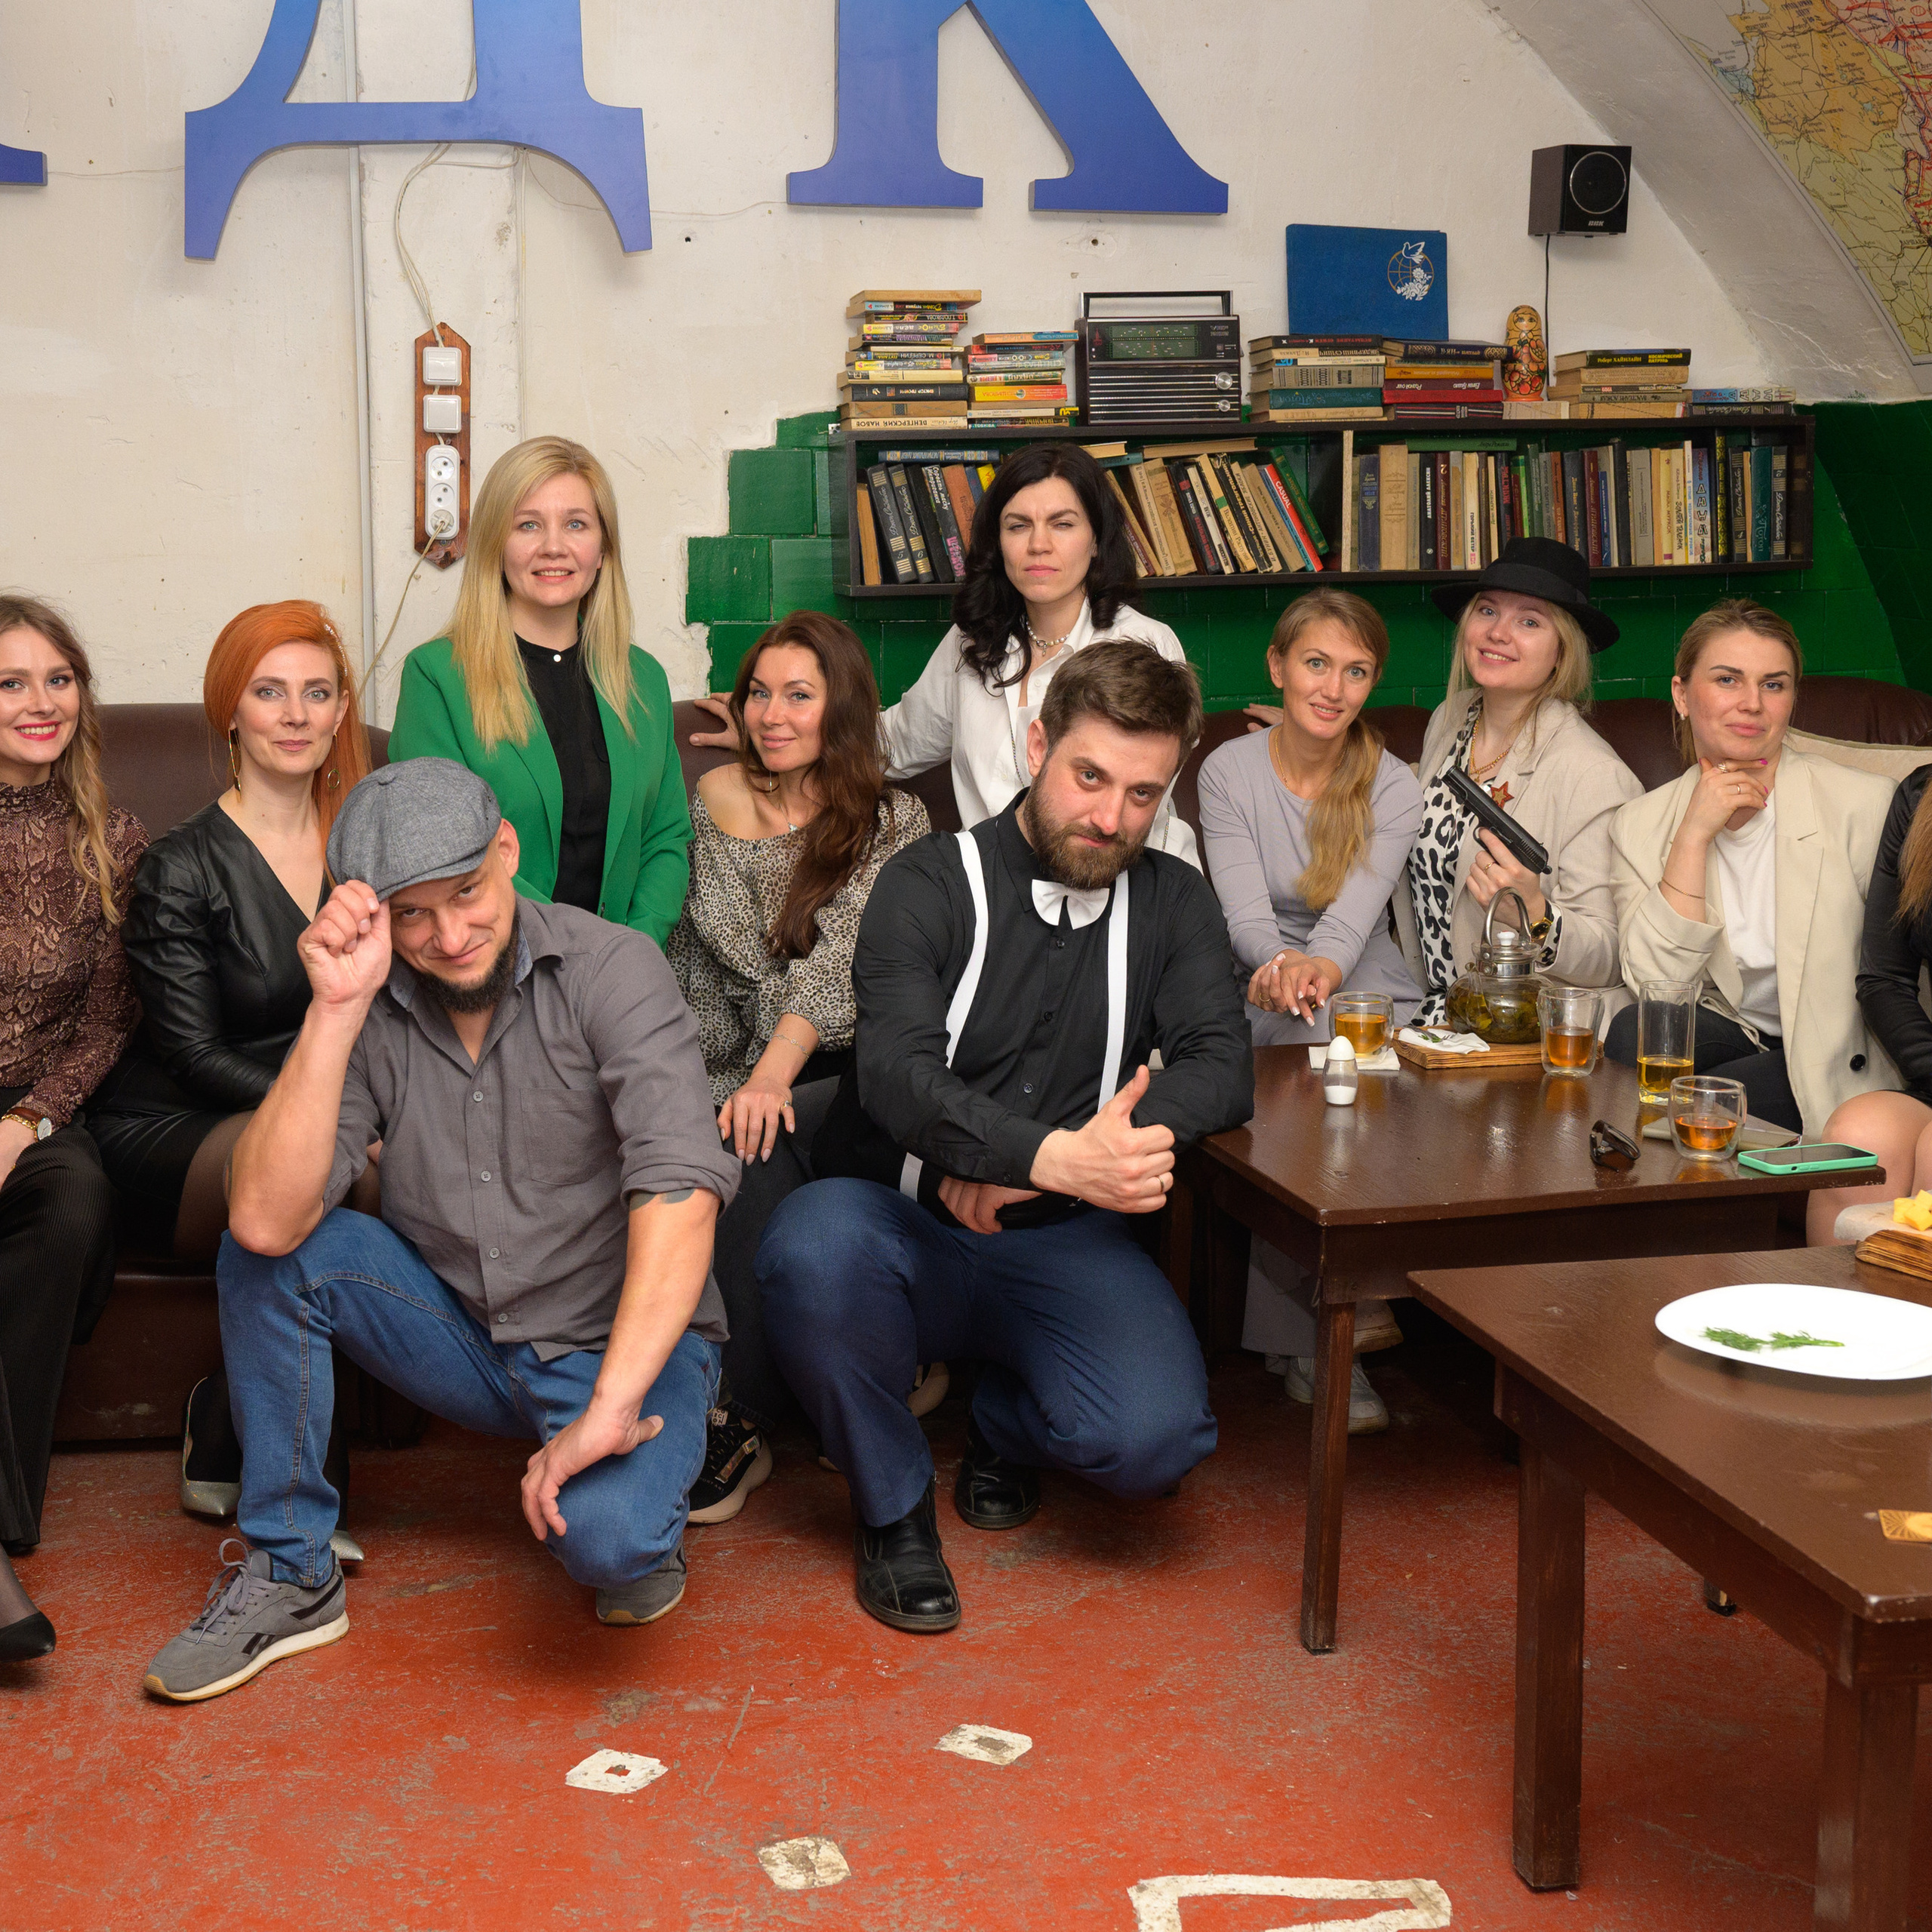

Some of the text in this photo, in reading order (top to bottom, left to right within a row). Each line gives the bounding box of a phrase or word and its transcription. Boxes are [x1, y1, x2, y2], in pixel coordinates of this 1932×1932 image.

[1440, 463, 1447, 474] 2
[925, 467, 941, 504] Интриганка
[931, 466, 951, 511] Сорвать маску
[1235, 472, 1247, 494] ЯБЛОКИ
[1274, 479, 1292, 509] CASUAL
[1244, 494, 1263, 532] АНТОНОВСКИЕ
[897, 550, 903, 559] 5
[917, 550, 924, 558] 6
